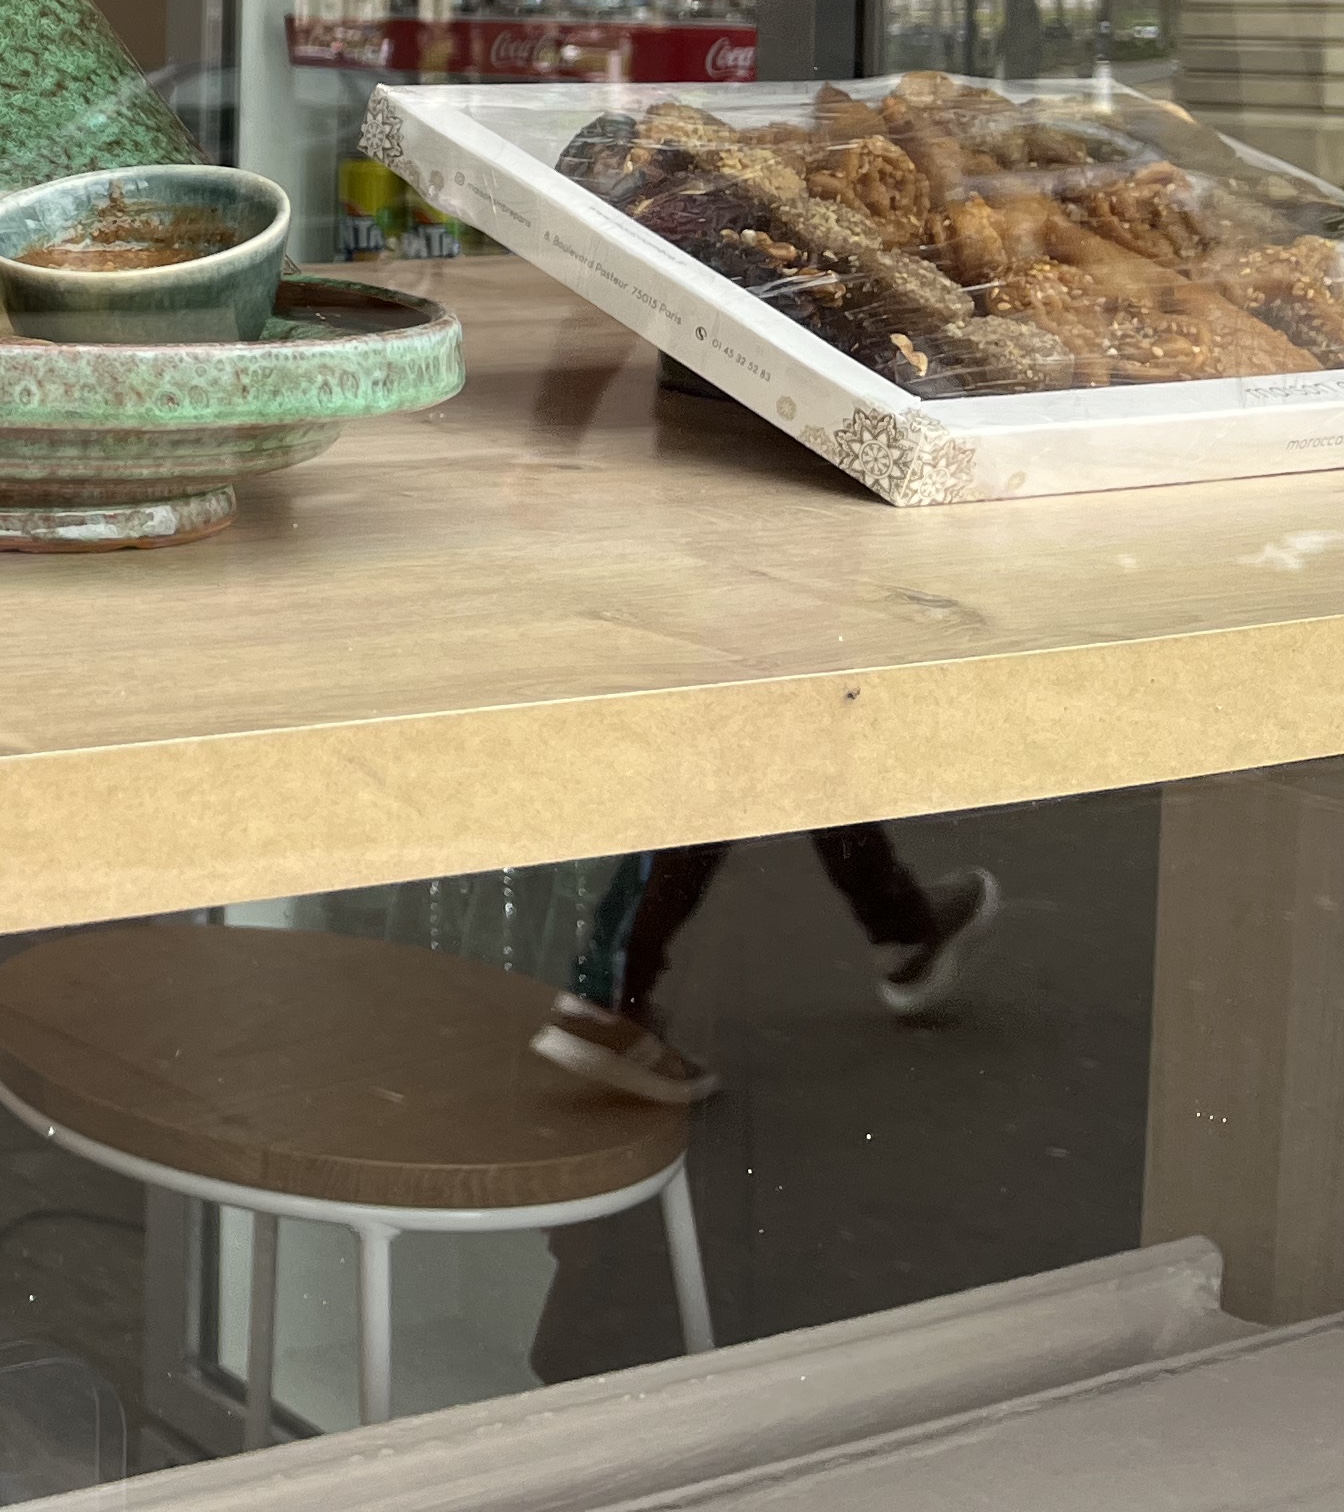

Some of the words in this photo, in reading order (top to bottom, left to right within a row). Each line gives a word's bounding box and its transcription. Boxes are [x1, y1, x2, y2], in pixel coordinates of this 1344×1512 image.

[553, 235, 595, 269] Boulevard
[595, 262, 628, 290] Pasteur
[631, 285, 658, 309] 75015
[659, 302, 682, 325] Paris
